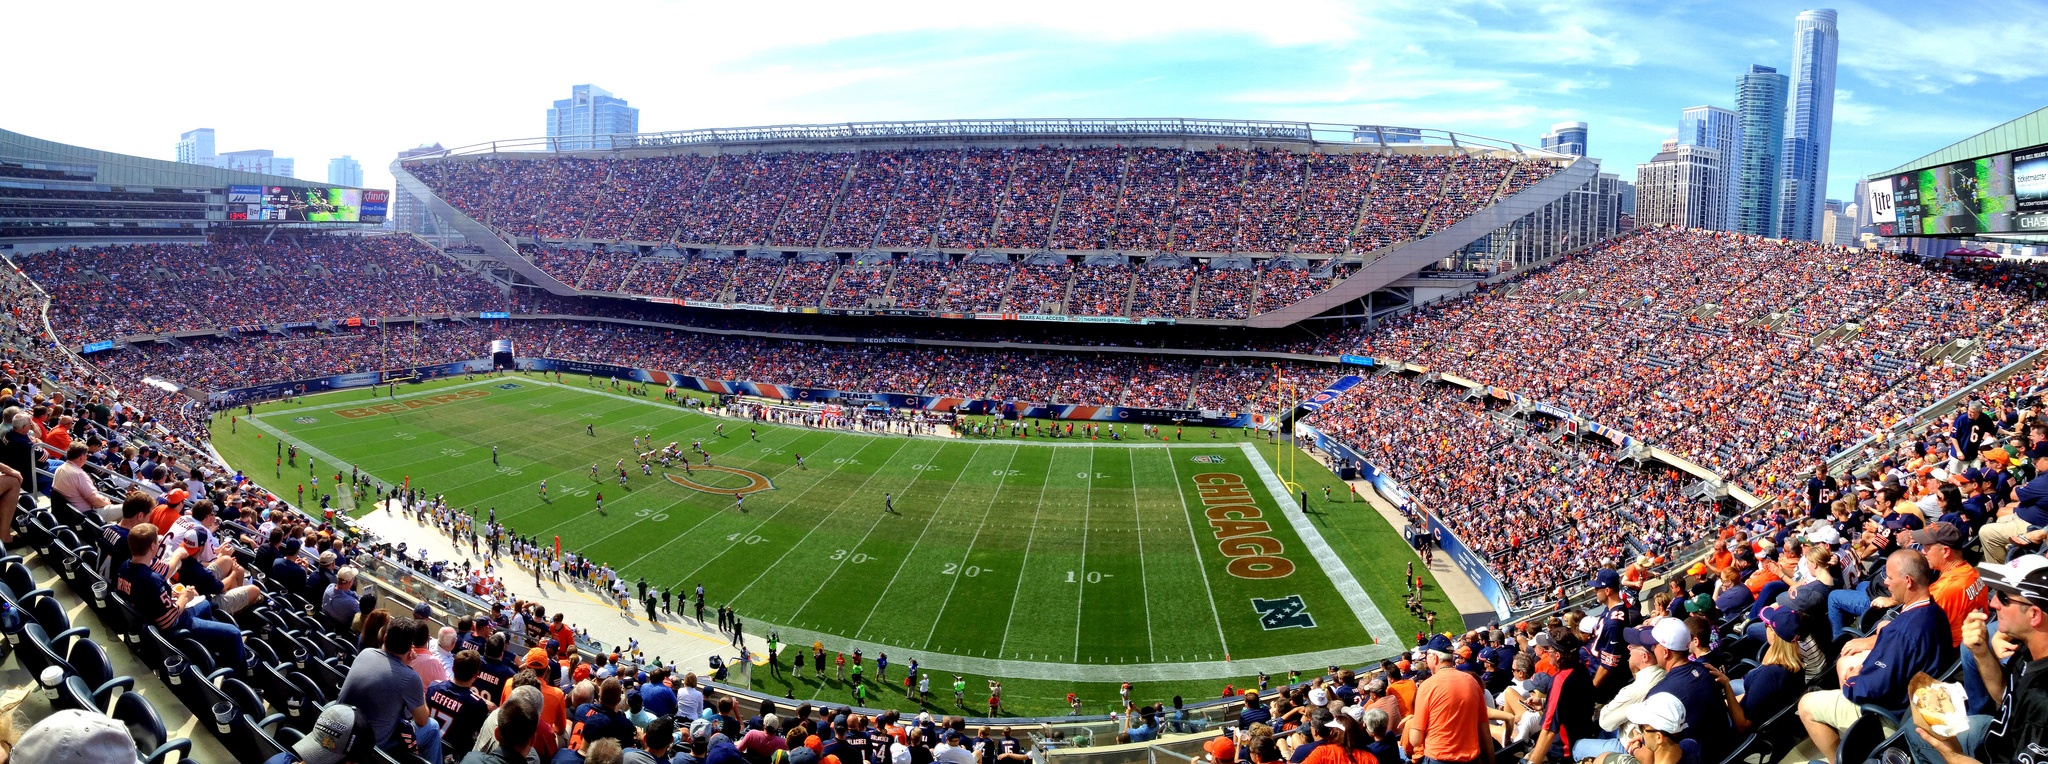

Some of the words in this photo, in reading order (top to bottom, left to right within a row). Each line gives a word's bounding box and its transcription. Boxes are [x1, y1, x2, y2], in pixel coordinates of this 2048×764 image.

[363, 191, 388, 202] xfinity
[1872, 192, 1891, 215] Lite
[840, 392, 873, 400] BEARS
[330, 389, 494, 419] BEARS
[1969, 425, 1979, 443] 6
[1818, 488, 1830, 504] 15
[634, 508, 669, 522] 50
[1191, 472, 1296, 580] CHICAGO
[156, 531, 174, 559] 6
[726, 532, 763, 545] 40
[829, 550, 868, 564] 30
[941, 563, 980, 578] 20
[1064, 571, 1101, 584] 10
[1610, 611, 1625, 620] 22
[462, 641, 479, 651] CUTLER
[431, 691, 463, 713] JEFFERY
[430, 706, 454, 739] 17
